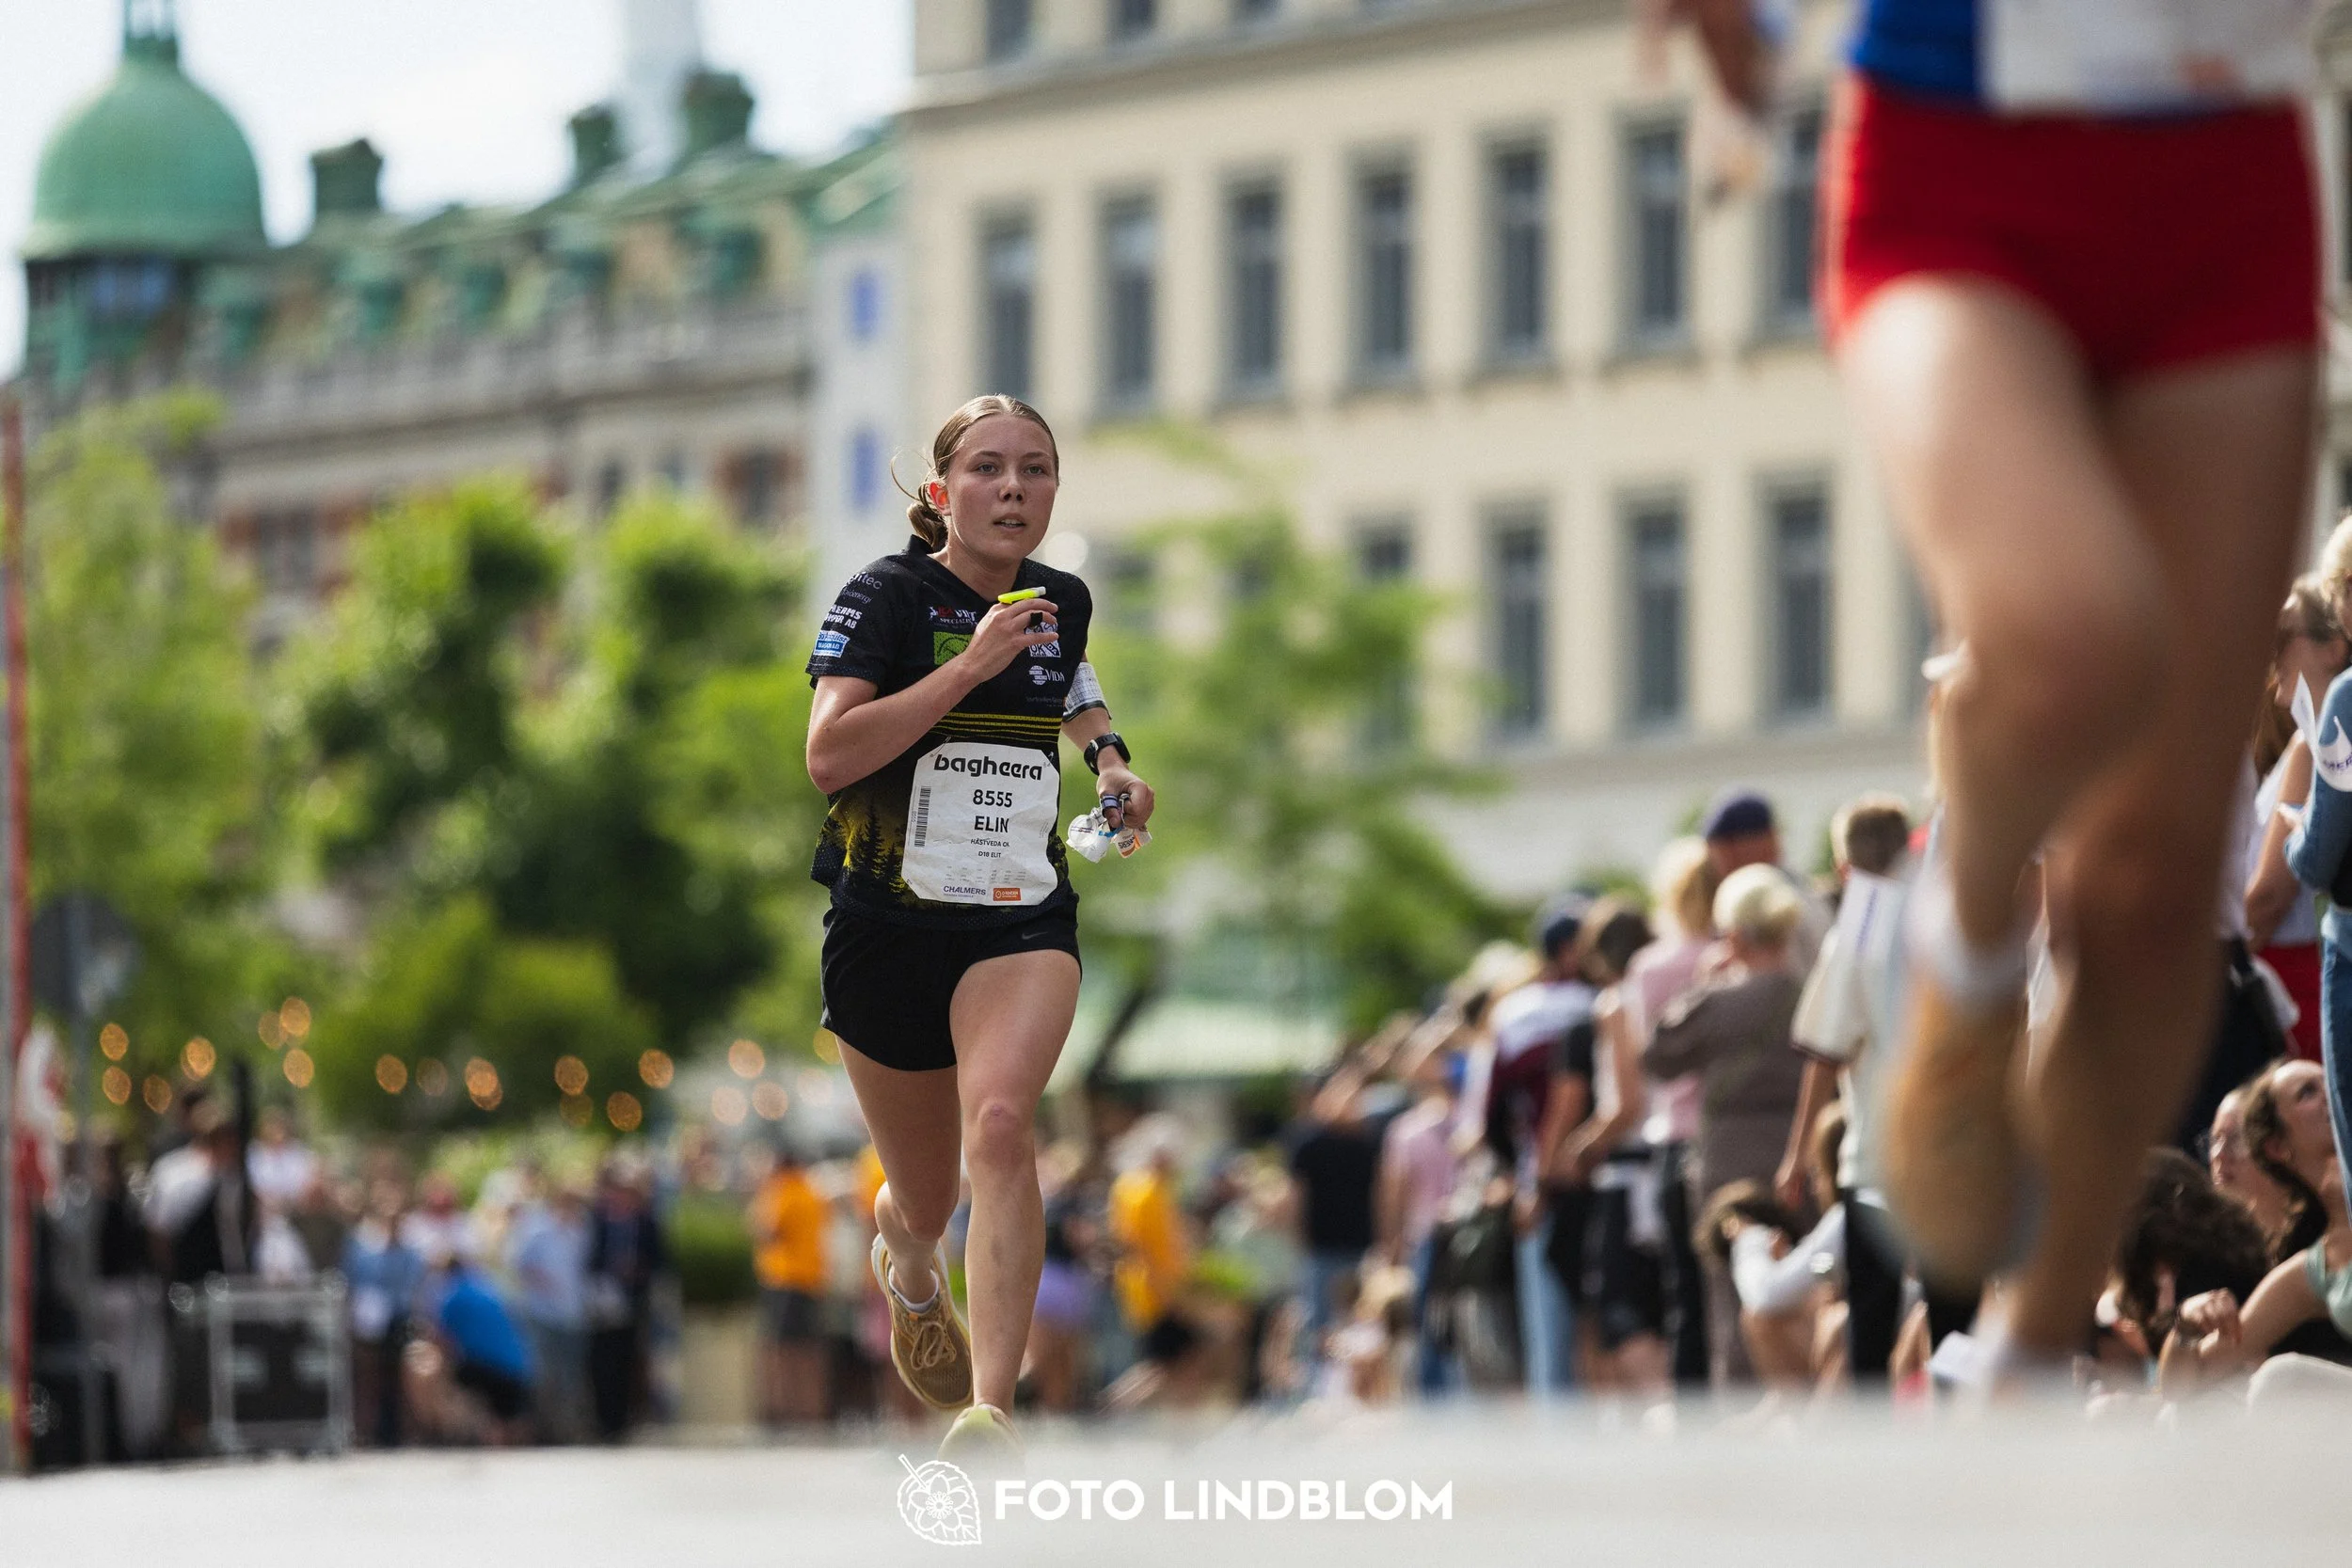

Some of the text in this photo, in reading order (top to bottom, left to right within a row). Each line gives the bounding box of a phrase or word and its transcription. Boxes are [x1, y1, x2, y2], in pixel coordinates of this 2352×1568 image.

[1044, 668, 1065, 682] VIDA
[933, 753, 1042, 781] bagheera
[973, 789, 1013, 808] 8555
[974, 816, 1009, 833] ELIN
[943, 885, 987, 896] CHALMERS
